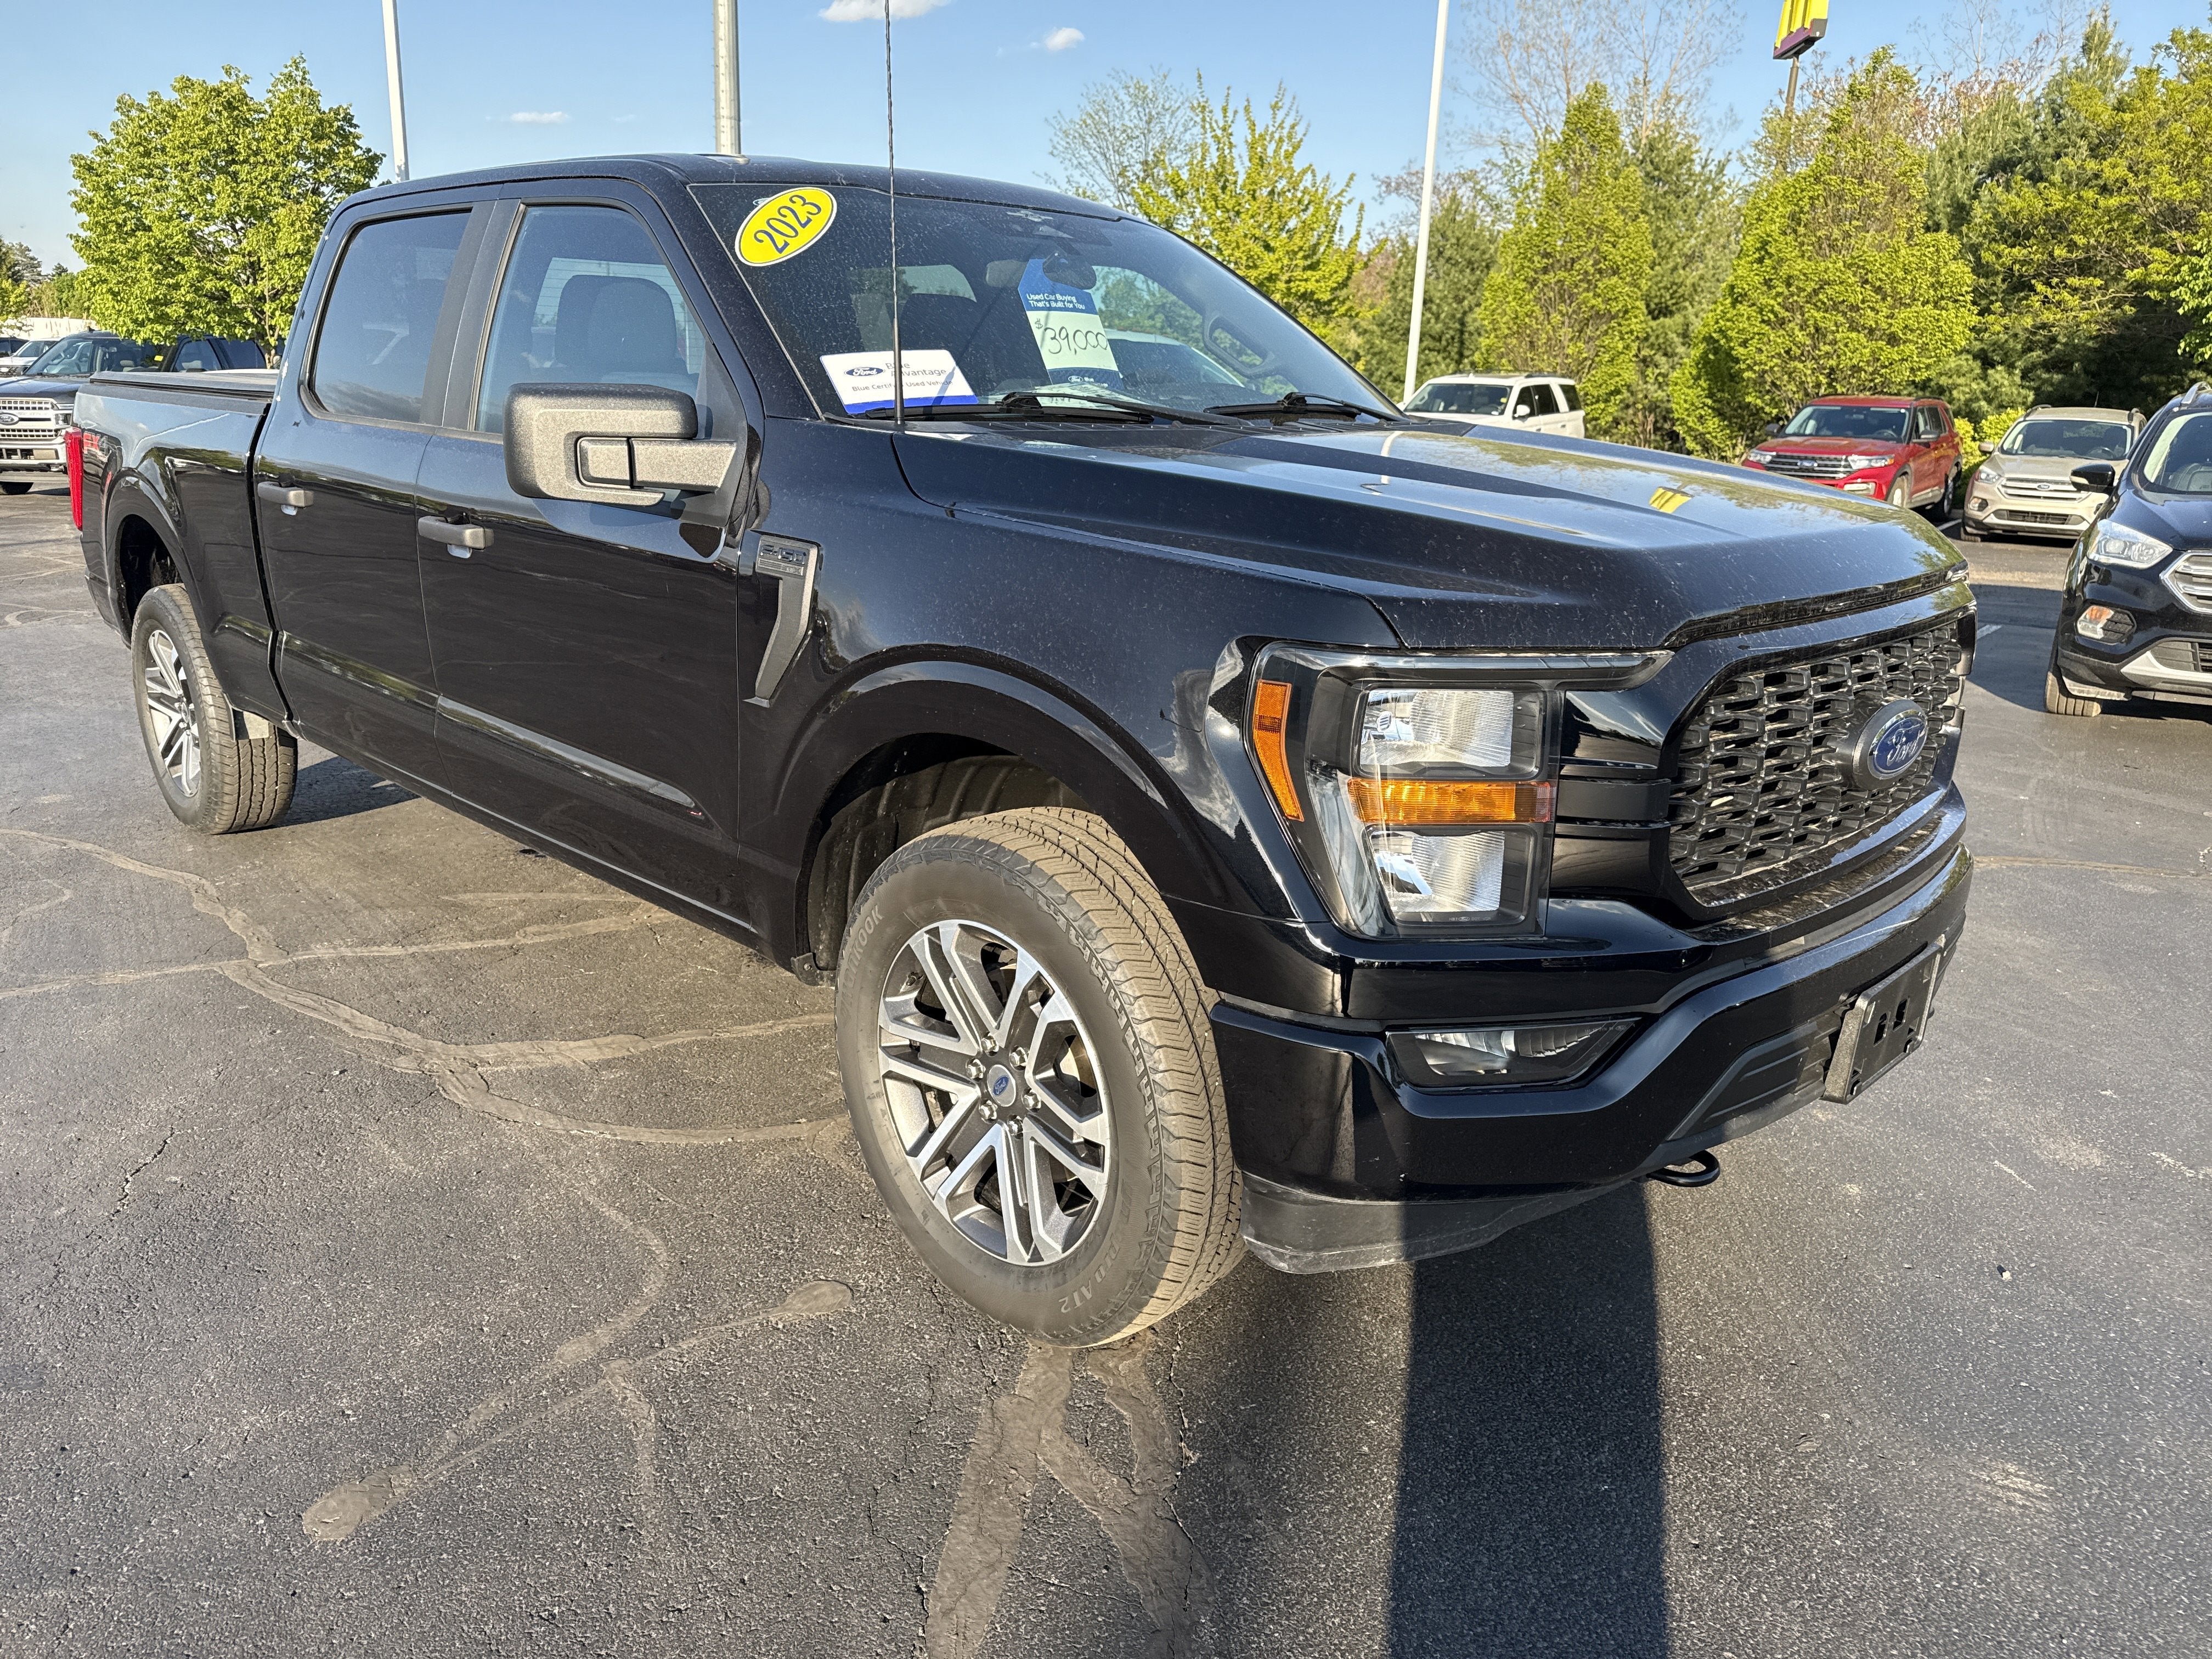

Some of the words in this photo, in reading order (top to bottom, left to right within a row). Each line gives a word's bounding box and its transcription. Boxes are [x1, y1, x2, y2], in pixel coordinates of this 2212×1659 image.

[754, 194, 822, 254] 2023
[1056, 294, 1077, 303] Buying
[1074, 302, 1086, 310] You
[852, 367, 878, 376] Ford
[83, 431, 108, 460] FX4
[1885, 722, 1922, 767] Ford
[994, 1077, 1007, 1094] Ford
